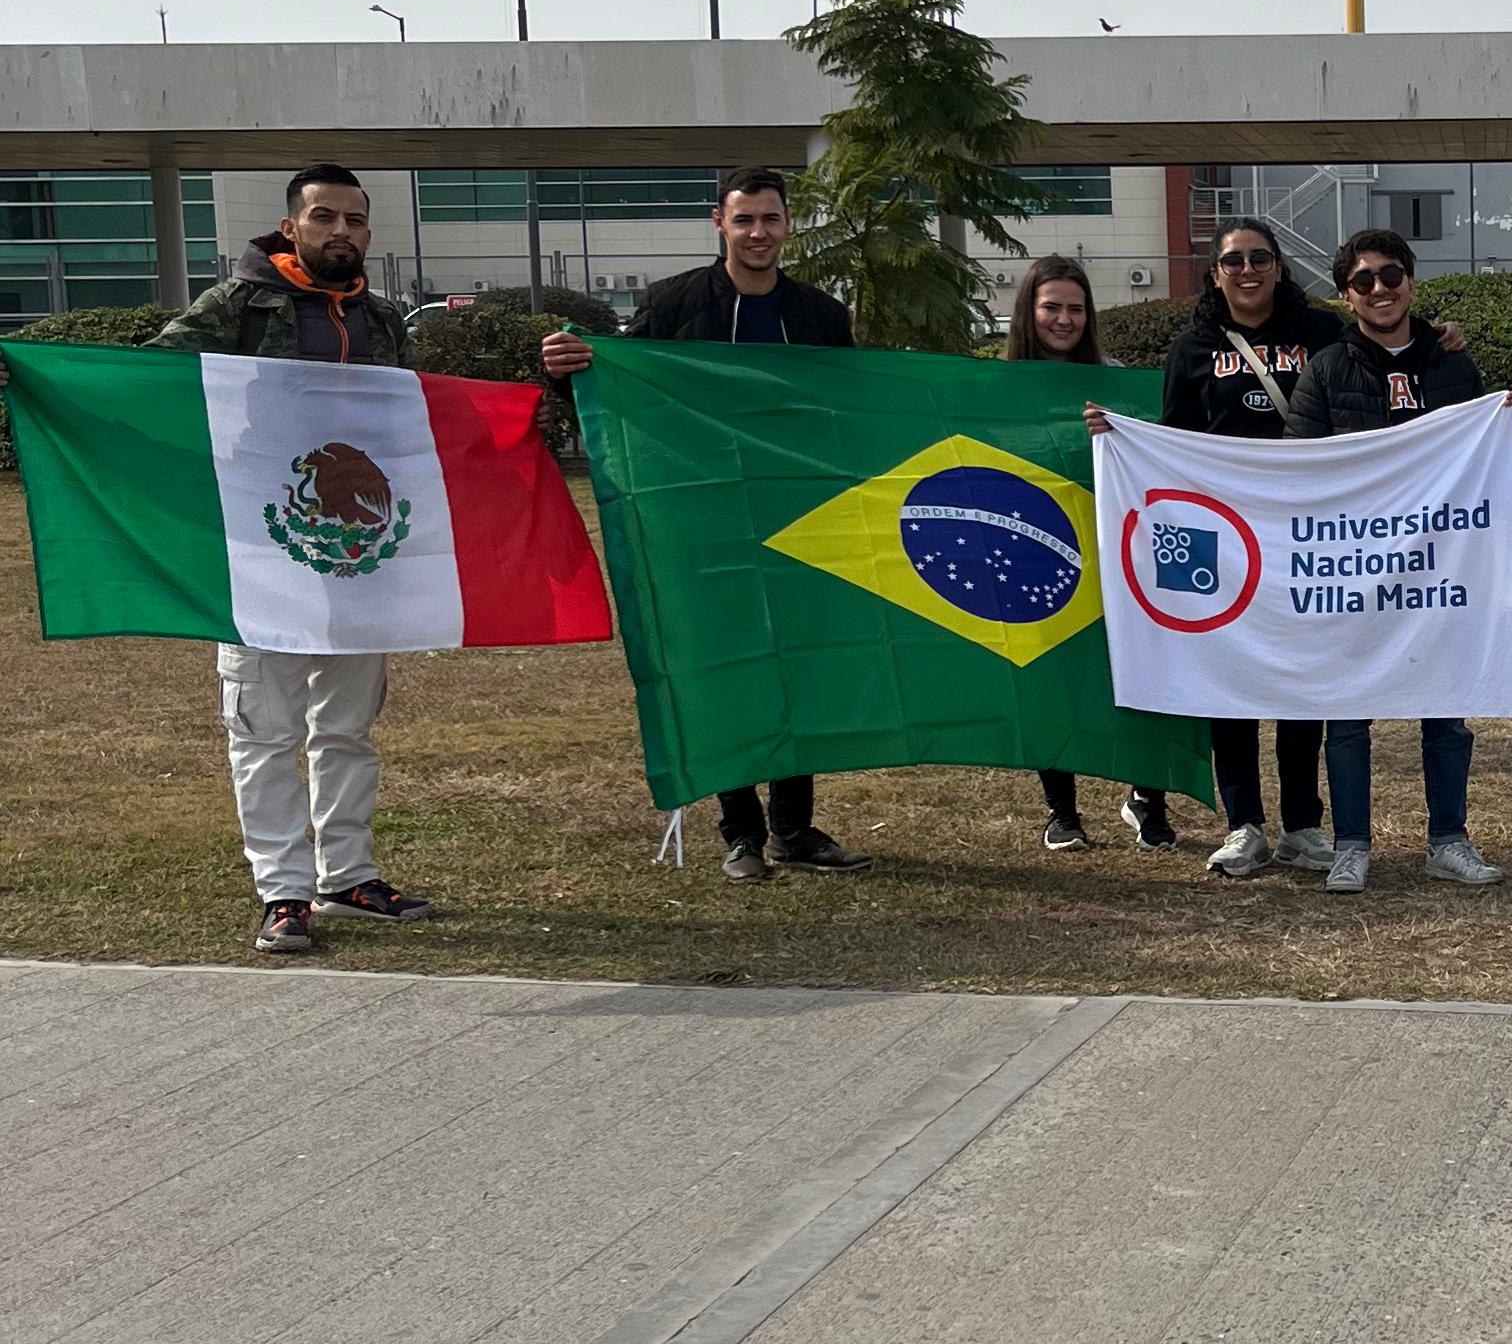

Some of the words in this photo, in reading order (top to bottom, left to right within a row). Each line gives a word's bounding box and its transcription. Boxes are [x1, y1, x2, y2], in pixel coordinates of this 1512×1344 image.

[1248, 393, 1274, 407] 197
[909, 507, 966, 519] ORDEM
[974, 511, 982, 520] E
[987, 514, 1078, 562] PROGRESSO
[1291, 499, 1491, 543] Universidad
[1291, 542, 1436, 578] Nacional
[1289, 585, 1365, 614] Villa
[1376, 579, 1468, 612] María
